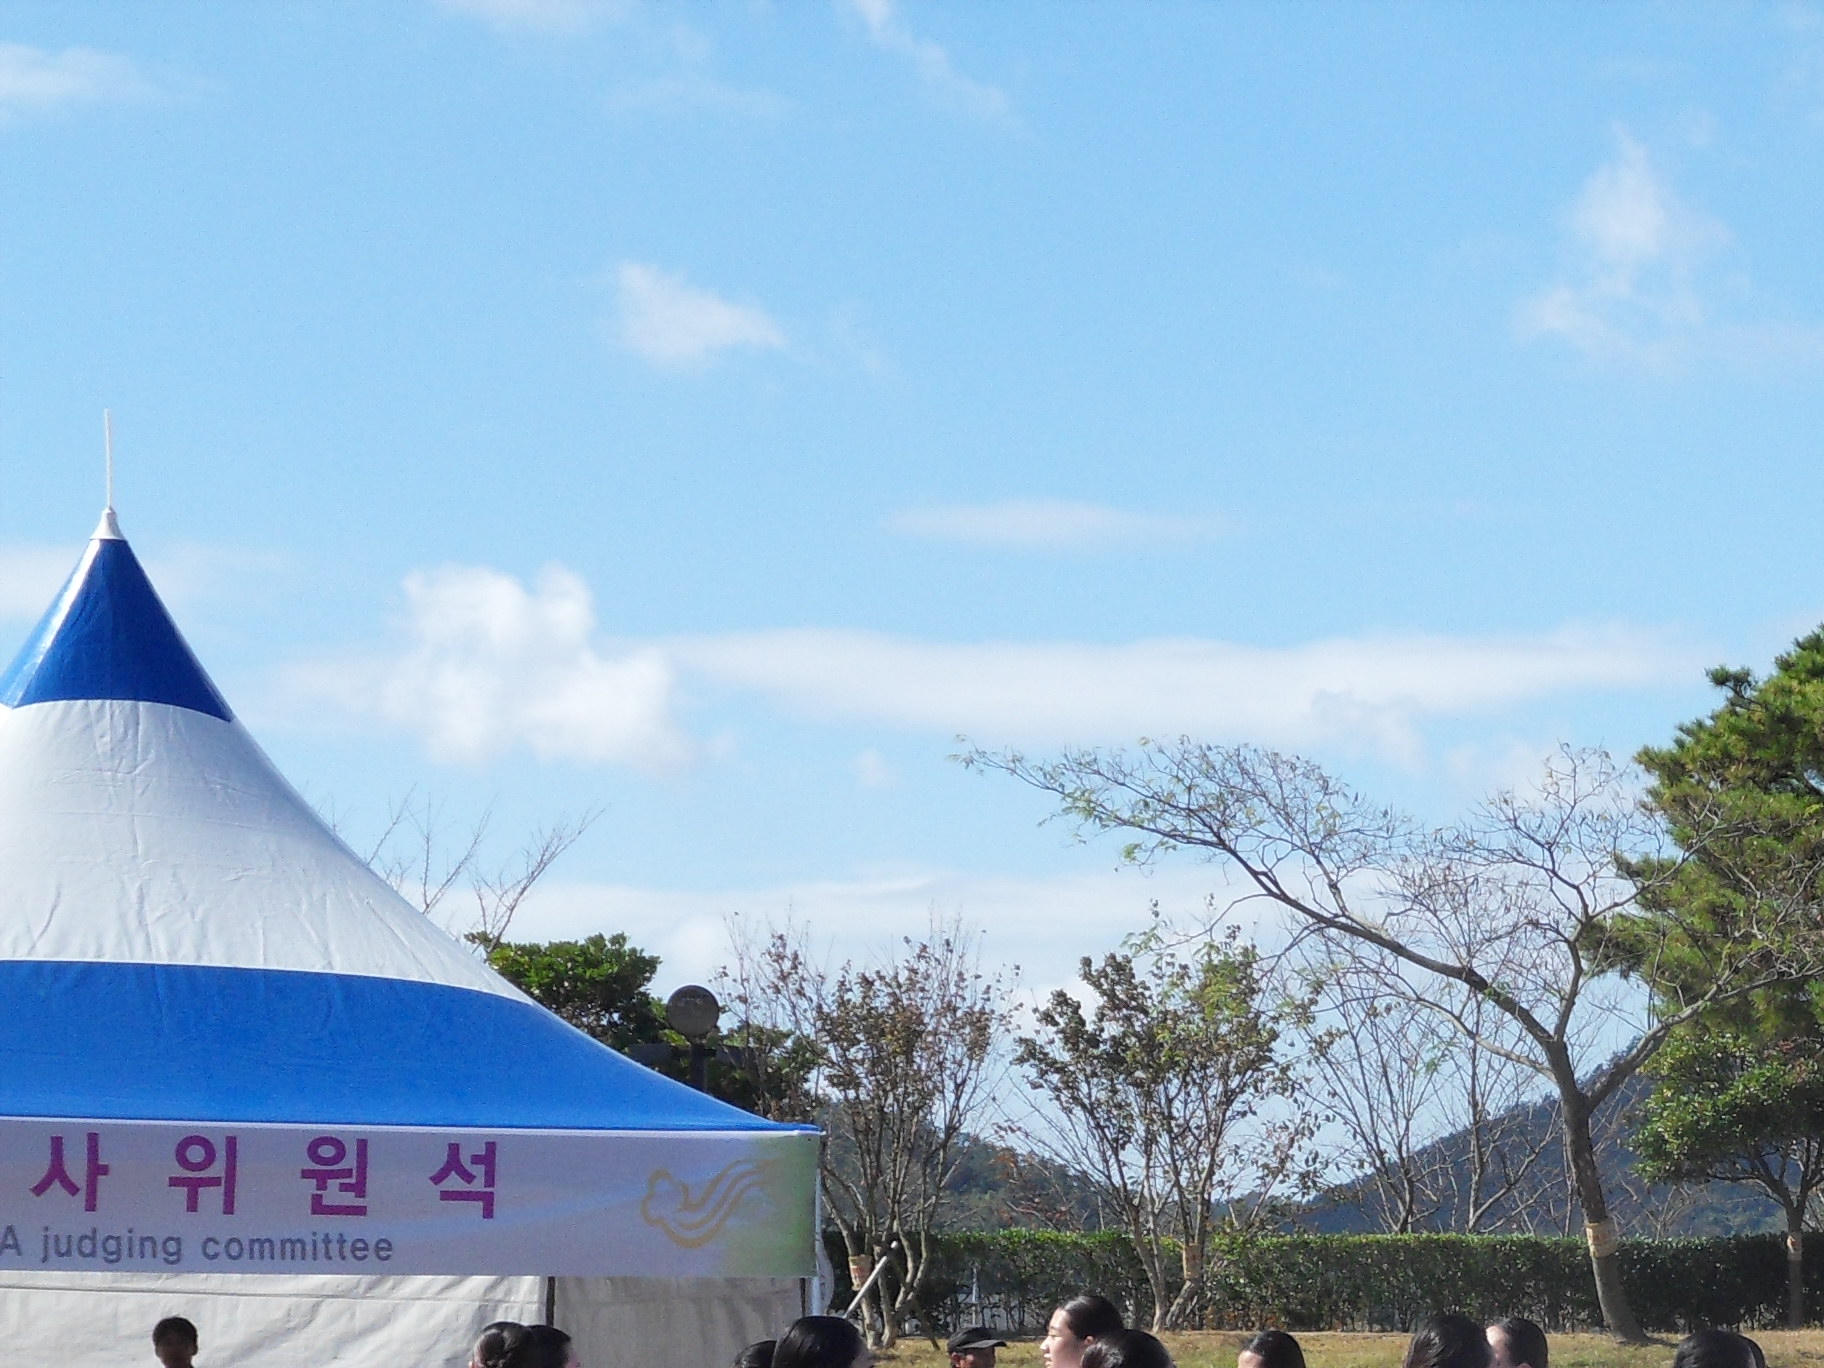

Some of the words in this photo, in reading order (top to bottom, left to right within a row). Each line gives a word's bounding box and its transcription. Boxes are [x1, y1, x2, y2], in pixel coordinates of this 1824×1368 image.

[0, 1224, 23, 1257] A
[39, 1226, 185, 1265] judging
[200, 1231, 395, 1262] committee
